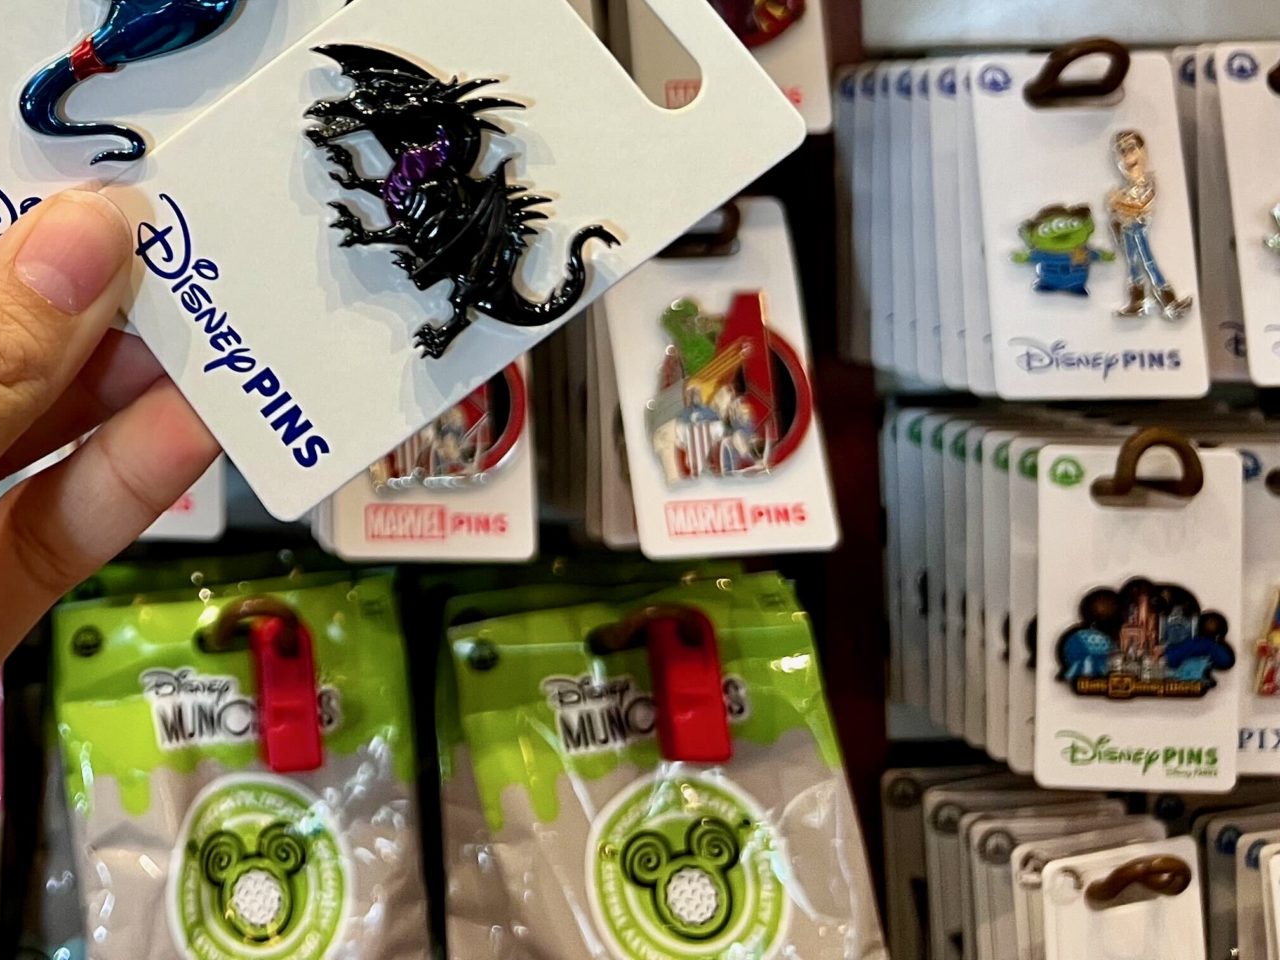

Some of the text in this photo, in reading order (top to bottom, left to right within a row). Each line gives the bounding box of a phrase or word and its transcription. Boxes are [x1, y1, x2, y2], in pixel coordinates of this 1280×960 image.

[135, 193, 330, 468] Disney PINS
[1008, 337, 1182, 382] Disney PINS
[364, 502, 509, 541] MARVEL PINS
[664, 499, 810, 540] MARVEL PINS
[1055, 729, 1218, 775] Disney PINS
